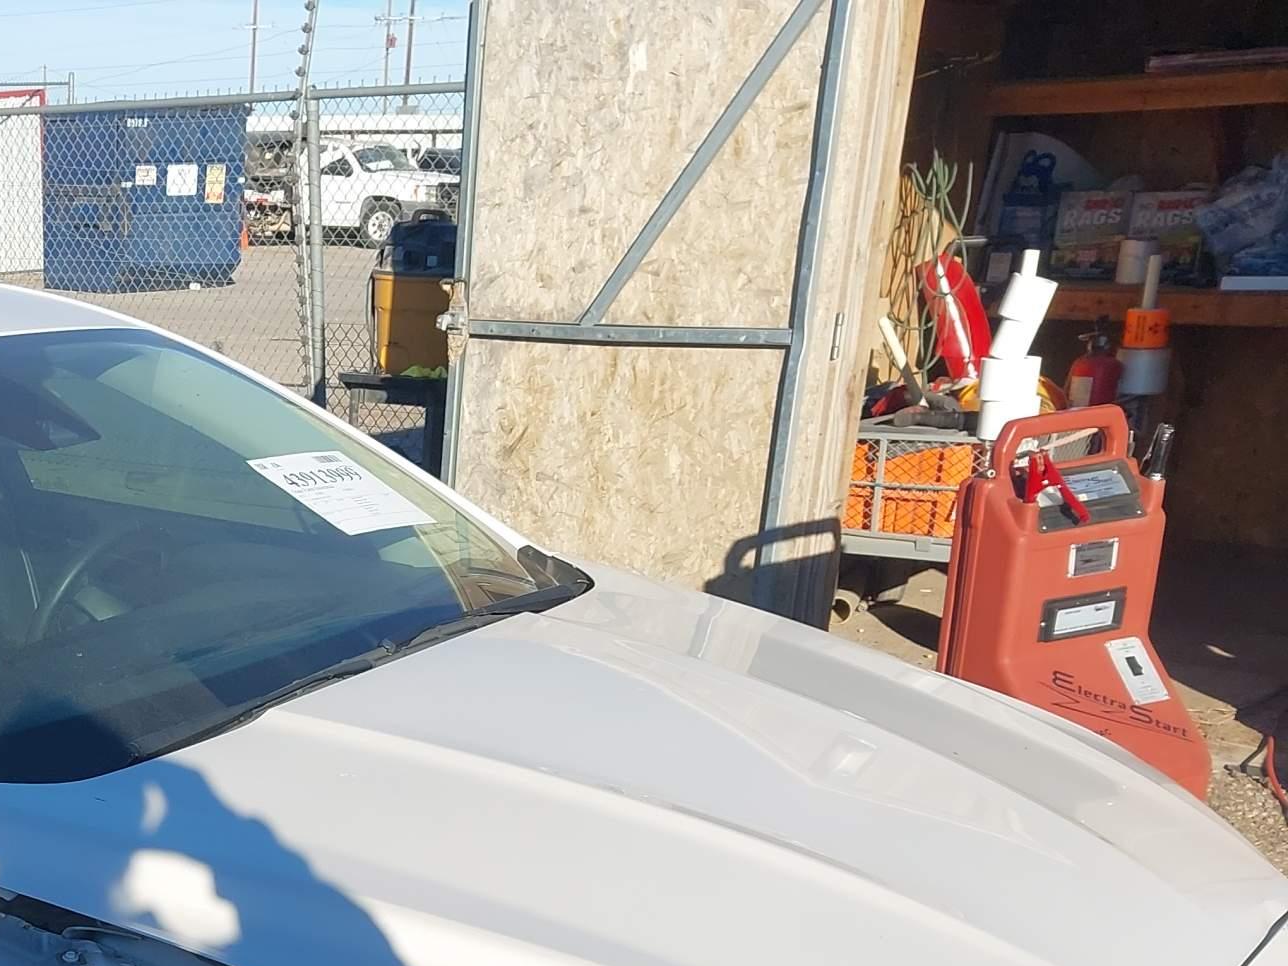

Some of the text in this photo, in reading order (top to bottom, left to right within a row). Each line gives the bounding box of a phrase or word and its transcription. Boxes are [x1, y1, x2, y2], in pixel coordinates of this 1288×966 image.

[1064, 207, 1122, 228] RAGS
[1135, 207, 1194, 227] RAGS
[282, 465, 362, 488] 43913999
